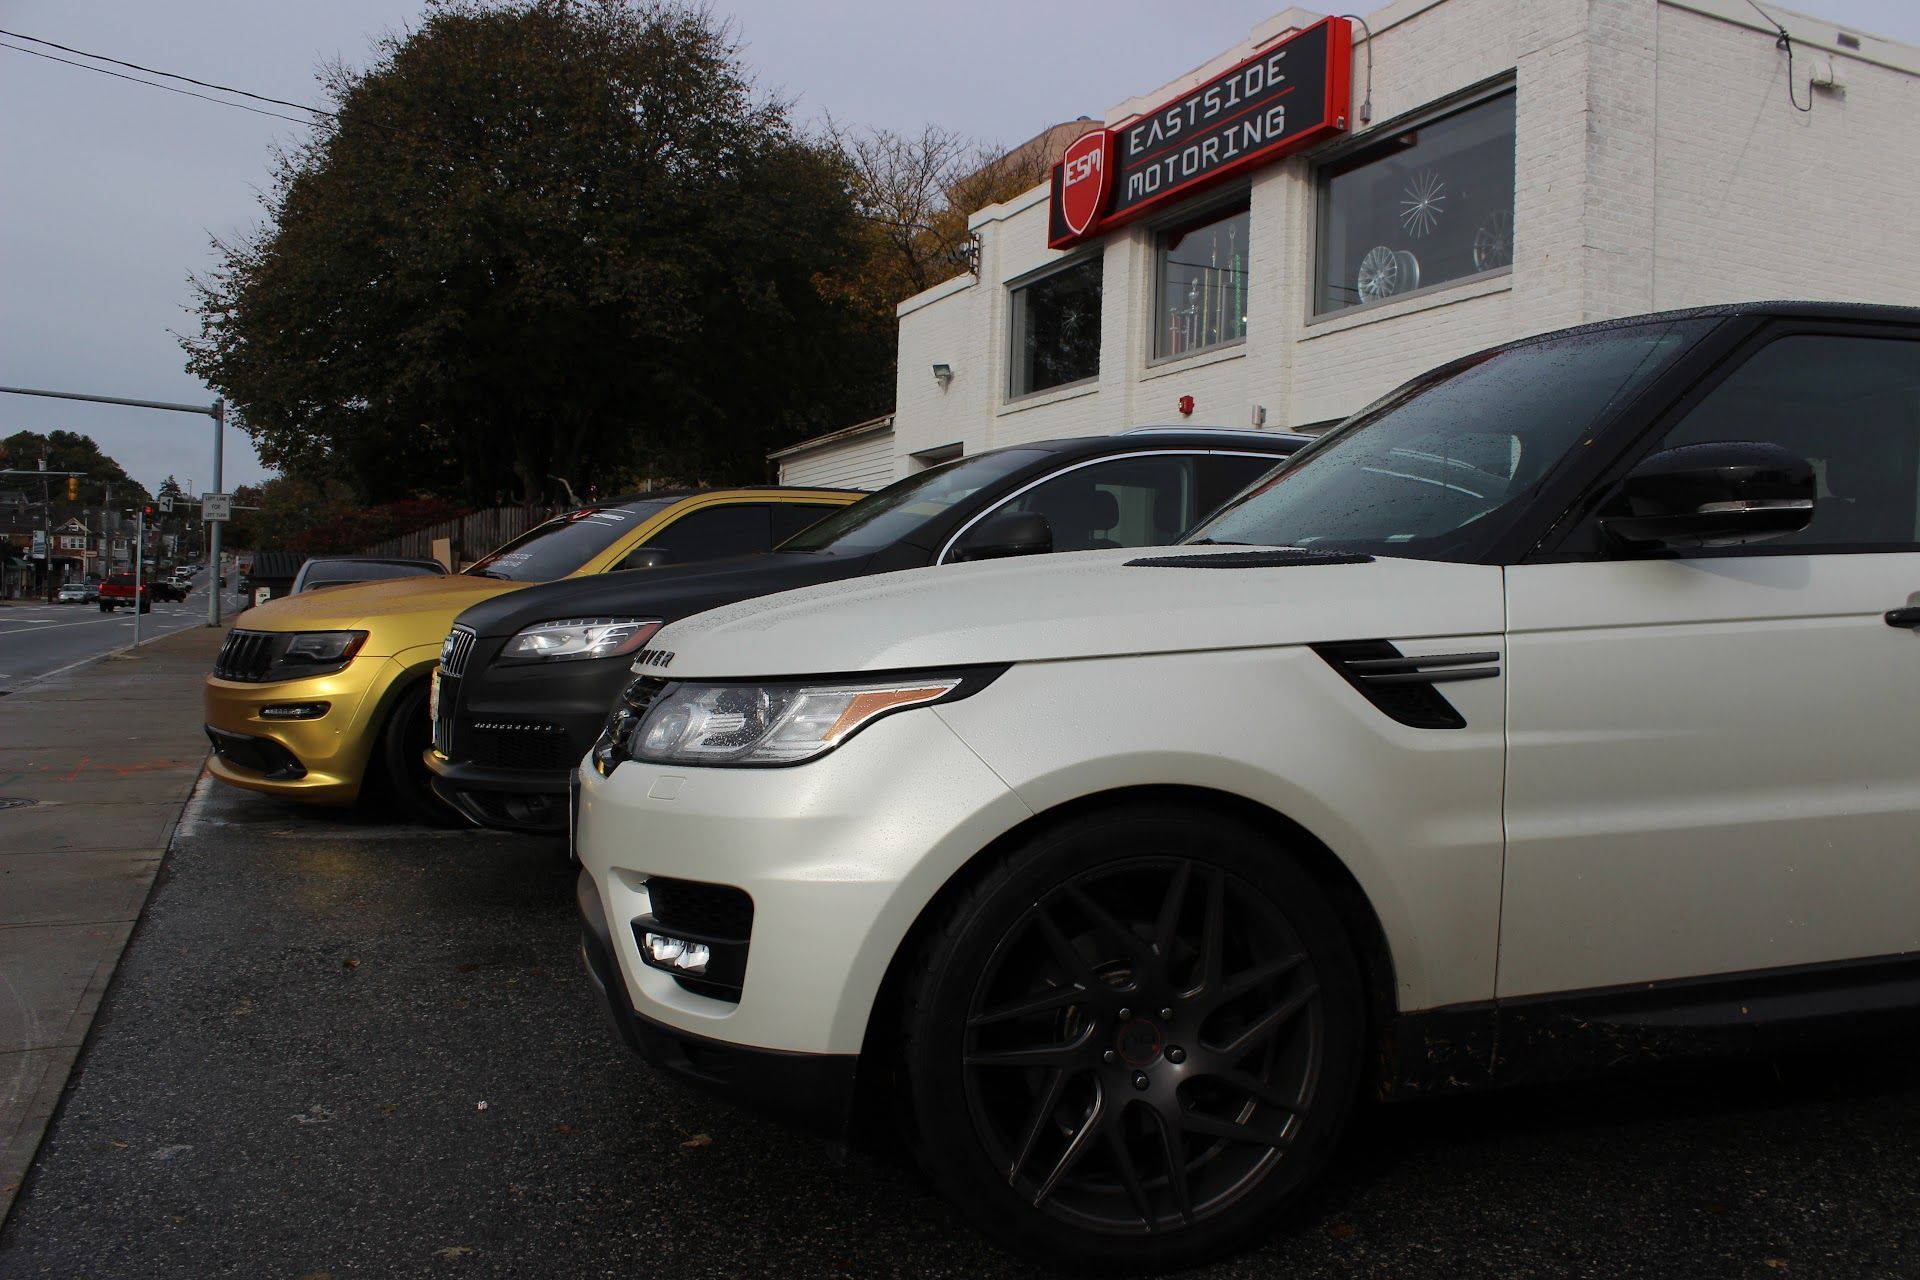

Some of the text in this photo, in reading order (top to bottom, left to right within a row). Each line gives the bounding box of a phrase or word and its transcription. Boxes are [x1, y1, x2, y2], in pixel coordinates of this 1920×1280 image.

[1129, 51, 1287, 156] EASTSIDE
[1065, 148, 1101, 188] ESM
[1128, 105, 1286, 201] MOTORING
